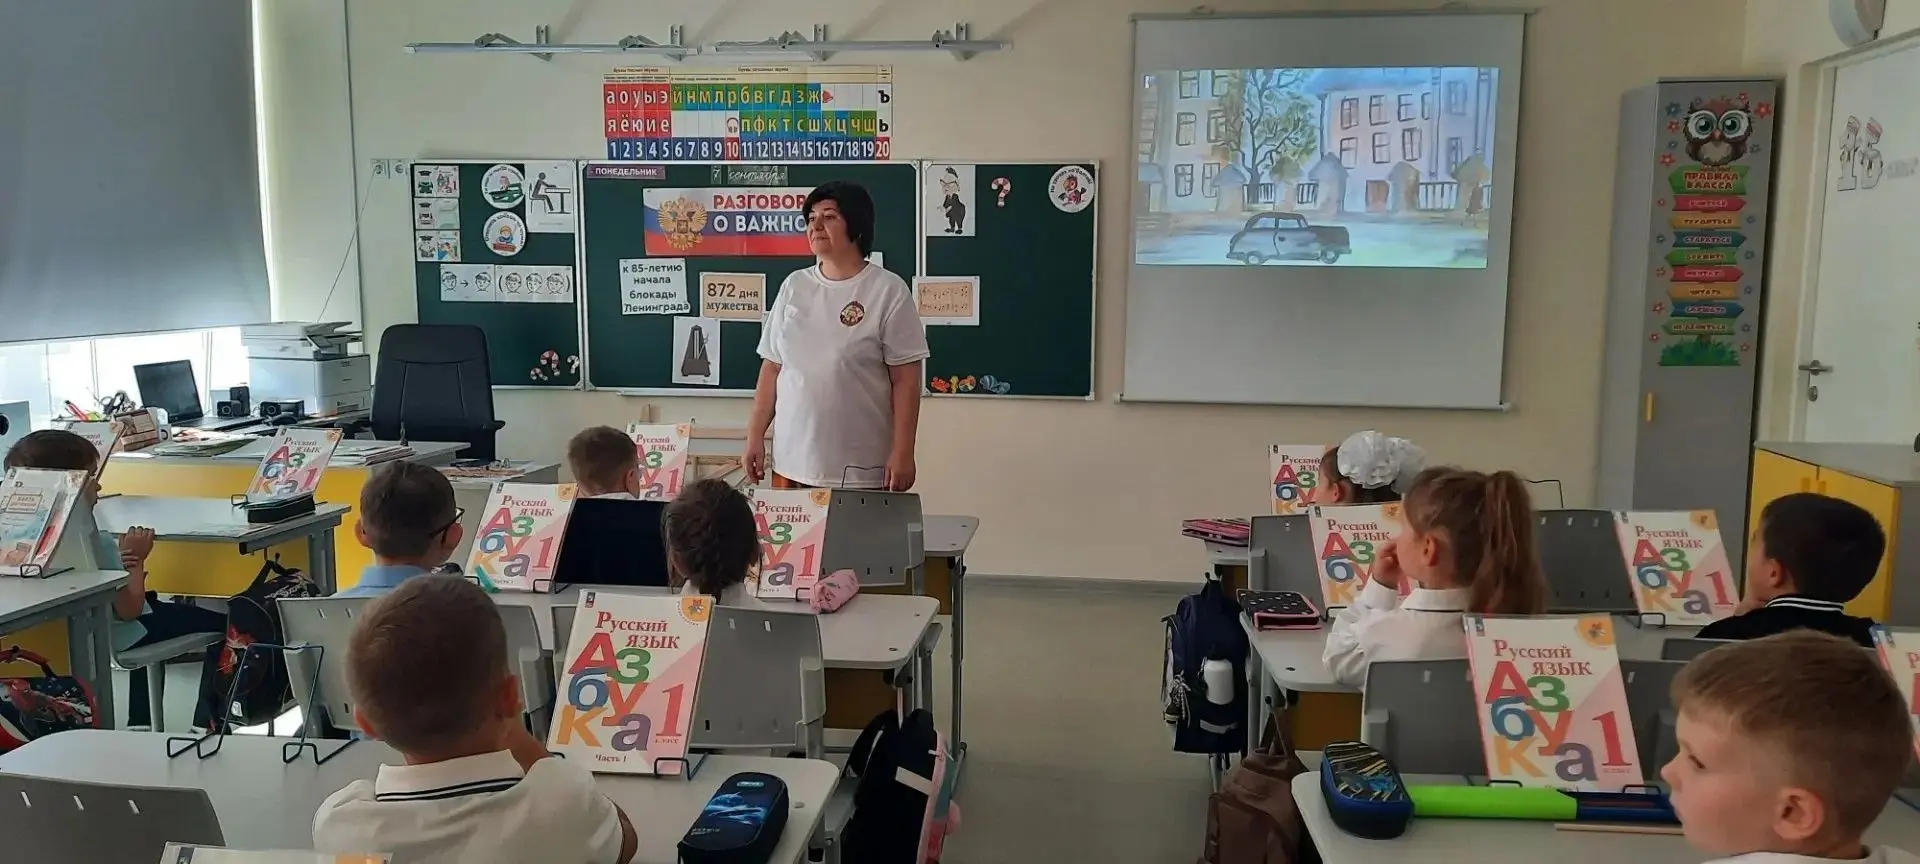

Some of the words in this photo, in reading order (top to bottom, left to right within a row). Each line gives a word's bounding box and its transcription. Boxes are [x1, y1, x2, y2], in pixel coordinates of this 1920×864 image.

[607, 91, 615, 104] а
[620, 91, 628, 103] о
[633, 91, 641, 107] у
[644, 91, 656, 102] ы
[660, 91, 668, 102] э
[674, 87, 682, 103] й
[687, 91, 695, 103] н
[700, 91, 711, 103] м
[714, 91, 724, 103] л
[728, 91, 736, 106] р
[741, 86, 749, 103] б
[754, 92, 762, 103] в
[769, 92, 776, 102] г
[780, 91, 791, 106] д
[797, 91, 804, 103] з
[809, 91, 819, 103] ж
[608, 119, 616, 131] я
[620, 114, 629, 131] ё
[632, 119, 643, 130] ю
[647, 119, 656, 130] и
[661, 119, 670, 131] е
[742, 119, 750, 131] п
[754, 116, 764, 135] ф
[769, 119, 777, 131] к
[782, 119, 791, 130] т
[798, 119, 804, 131] с
[809, 119, 820, 130] ш
[824, 119, 832, 130] х
[836, 119, 846, 134] ц
[851, 119, 860, 130] ч
[864, 119, 876, 134] щ
[611, 142, 617, 158] 1
[623, 142, 630, 158] 2
[636, 142, 642, 158] 3
[649, 142, 657, 158] 4
[662, 142, 669, 158] 5
[675, 142, 682, 158] 6
[688, 142, 695, 158] 7
[702, 142, 708, 158] 8
[715, 142, 722, 158] 9
[727, 142, 738, 158] 10
[742, 142, 752, 158] 11
[757, 142, 768, 158] 12
[772, 142, 783, 158] 13
[786, 142, 798, 158] 14
[802, 142, 813, 158] 15
[816, 142, 828, 158] 16
[832, 142, 843, 158] 17
[847, 142, 858, 158] 18
[862, 142, 874, 158] 19
[876, 142, 889, 158] 20
[596, 167, 657, 176] ПОНЕДЕЛЬНИК
[713, 169, 720, 178] 7
[728, 166, 785, 184] сентября
[713, 194, 806, 209] РАЗГОВОР
[713, 215, 728, 232] О
[735, 215, 807, 232] ВАЖНО
[631, 264, 683, 273] 85-летию
[633, 276, 671, 284] начала
[629, 290, 677, 299] блокады
[707, 283, 736, 298] 872
[739, 290, 759, 299] дня
[624, 303, 689, 313] Ленинграда
[706, 301, 759, 312] мужества
[301, 467, 318, 490] 1
[666, 468, 679, 493] 1
[755, 501, 803, 514] Русский
[1327, 519, 1378, 531] Русский
[1635, 525, 1688, 539] Русский
[532, 536, 553, 568] 1
[798, 544, 815, 577] 1
[1705, 570, 1734, 605] 1
[595, 611, 668, 633] Русский
[1492, 639, 1571, 661] Русский
[655, 683, 684, 736] 1
[1591, 711, 1633, 766] 1
[596, 754, 620, 762] Часть
